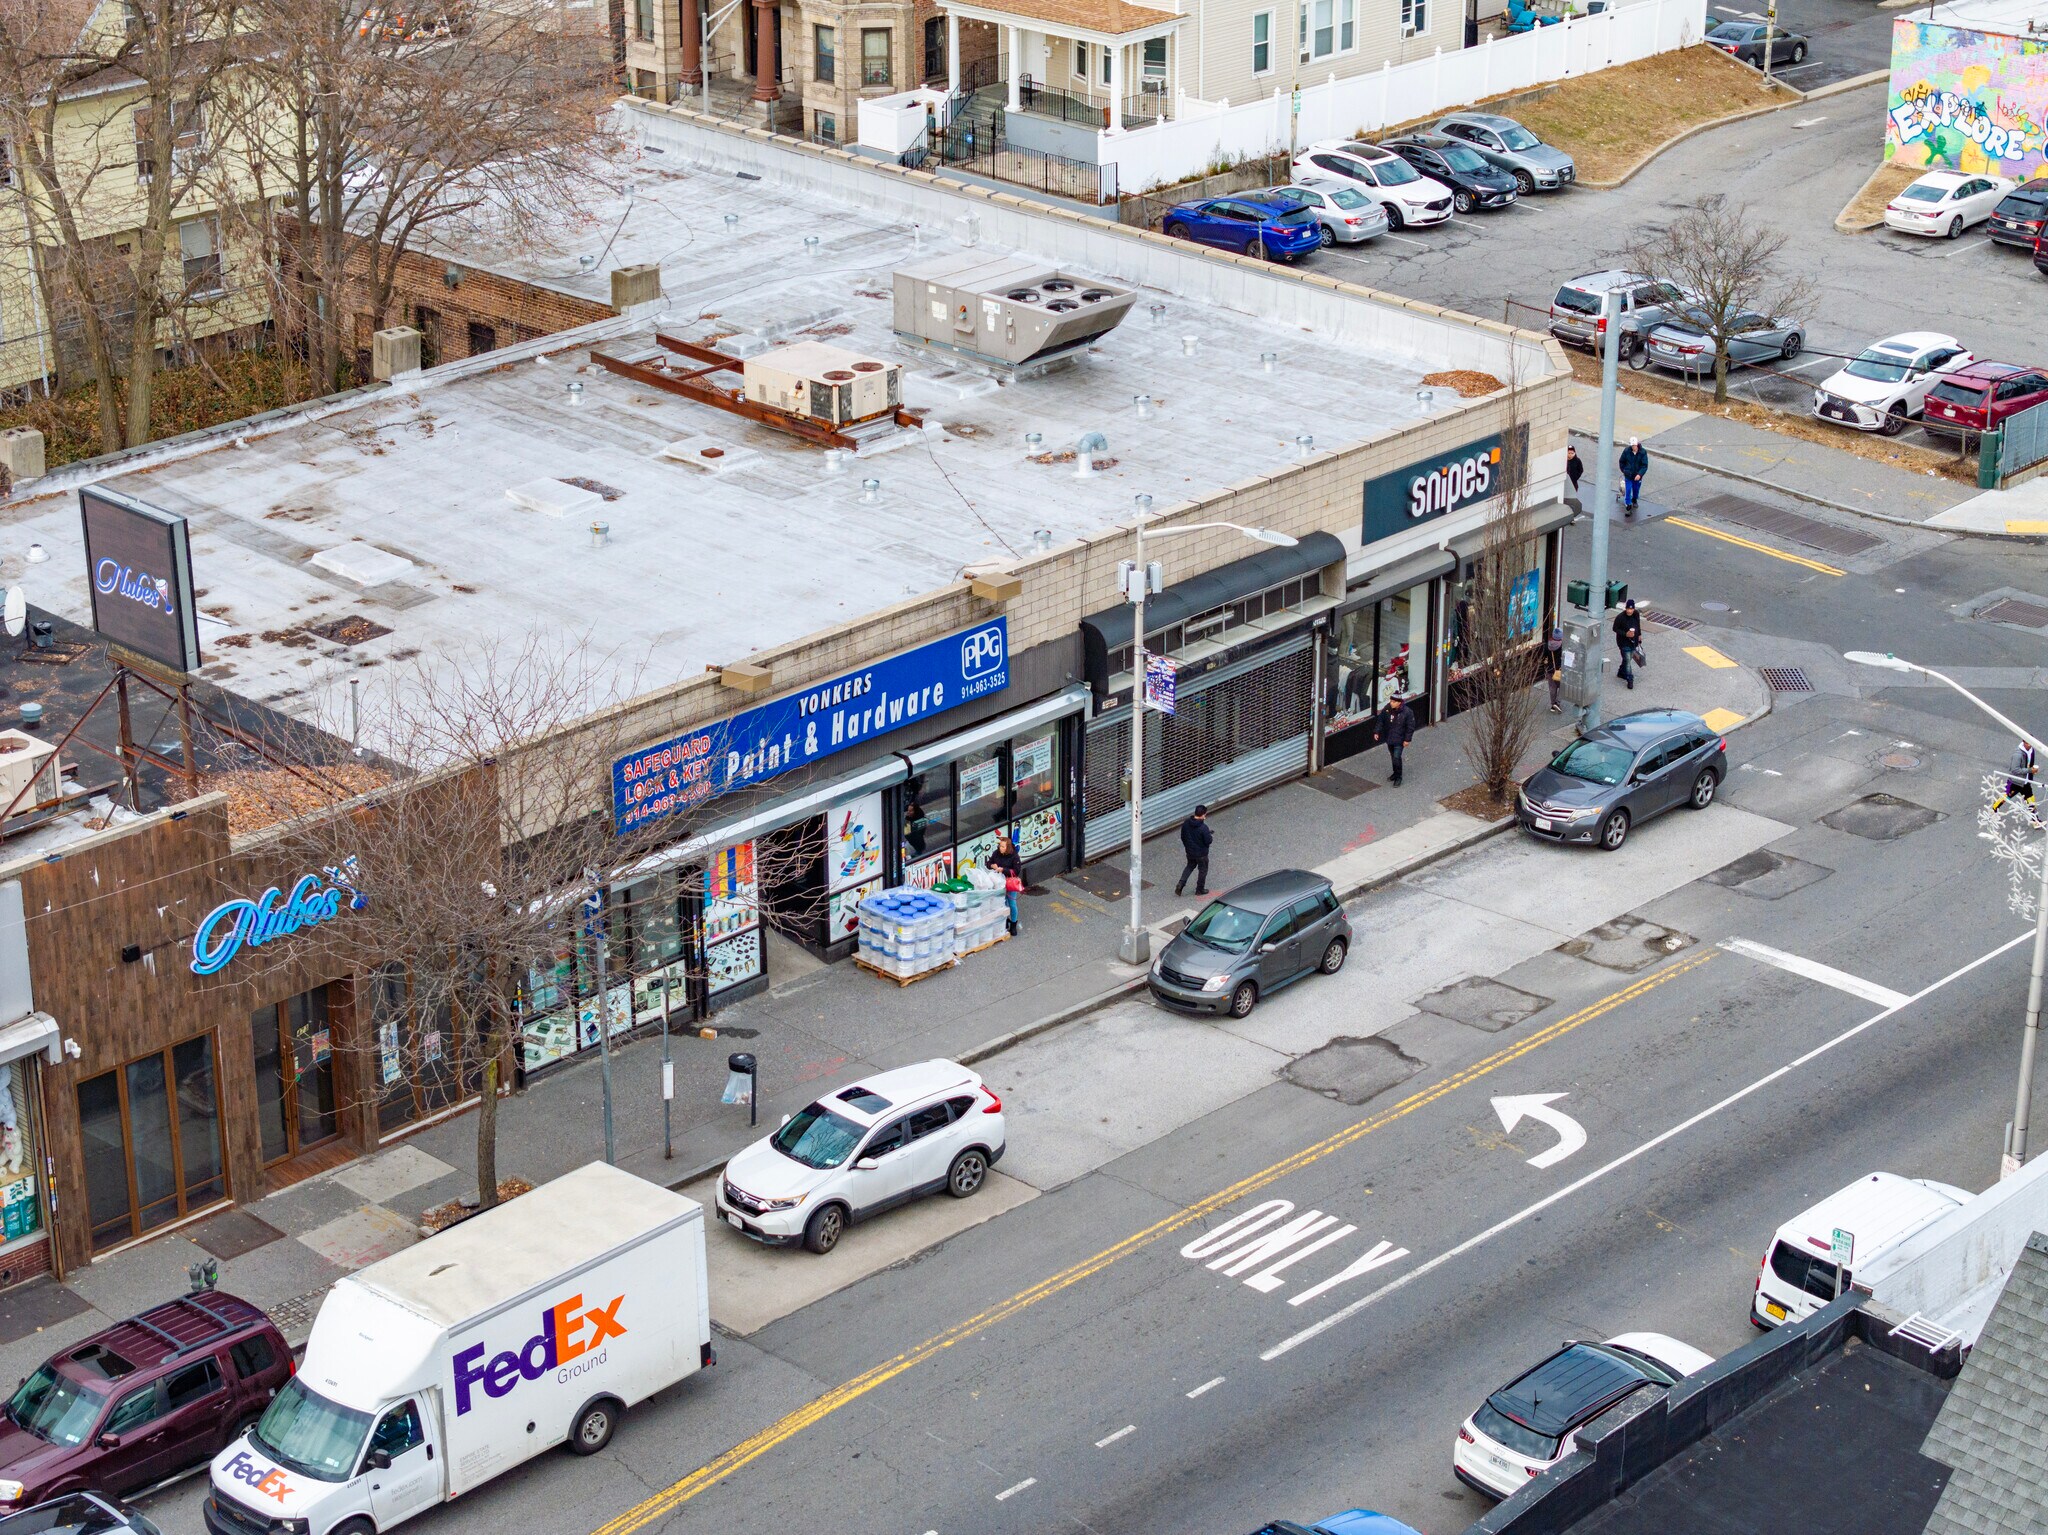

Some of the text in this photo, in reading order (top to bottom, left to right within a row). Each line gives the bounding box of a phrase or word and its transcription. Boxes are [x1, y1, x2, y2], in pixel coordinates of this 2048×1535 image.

[1889, 92, 2027, 161] EXPLORE
[1410, 452, 1490, 518] snipes
[96, 557, 159, 608] Nubes
[965, 632, 1000, 669] PPG
[798, 673, 872, 718] YONKERS
[961, 671, 1006, 699] 914-963-3525
[624, 735, 711, 782] SAFEGUARD
[727, 682, 944, 783] Paint & Hardware
[625, 757, 711, 805] LOCK & KEY
[189, 873, 342, 975] Nubes
[1180, 1199, 1411, 1307] ONLY
[453, 1293, 628, 1417] FedEx
[557, 1348, 608, 1384] Ground
[222, 1451, 296, 1504] FedEx
